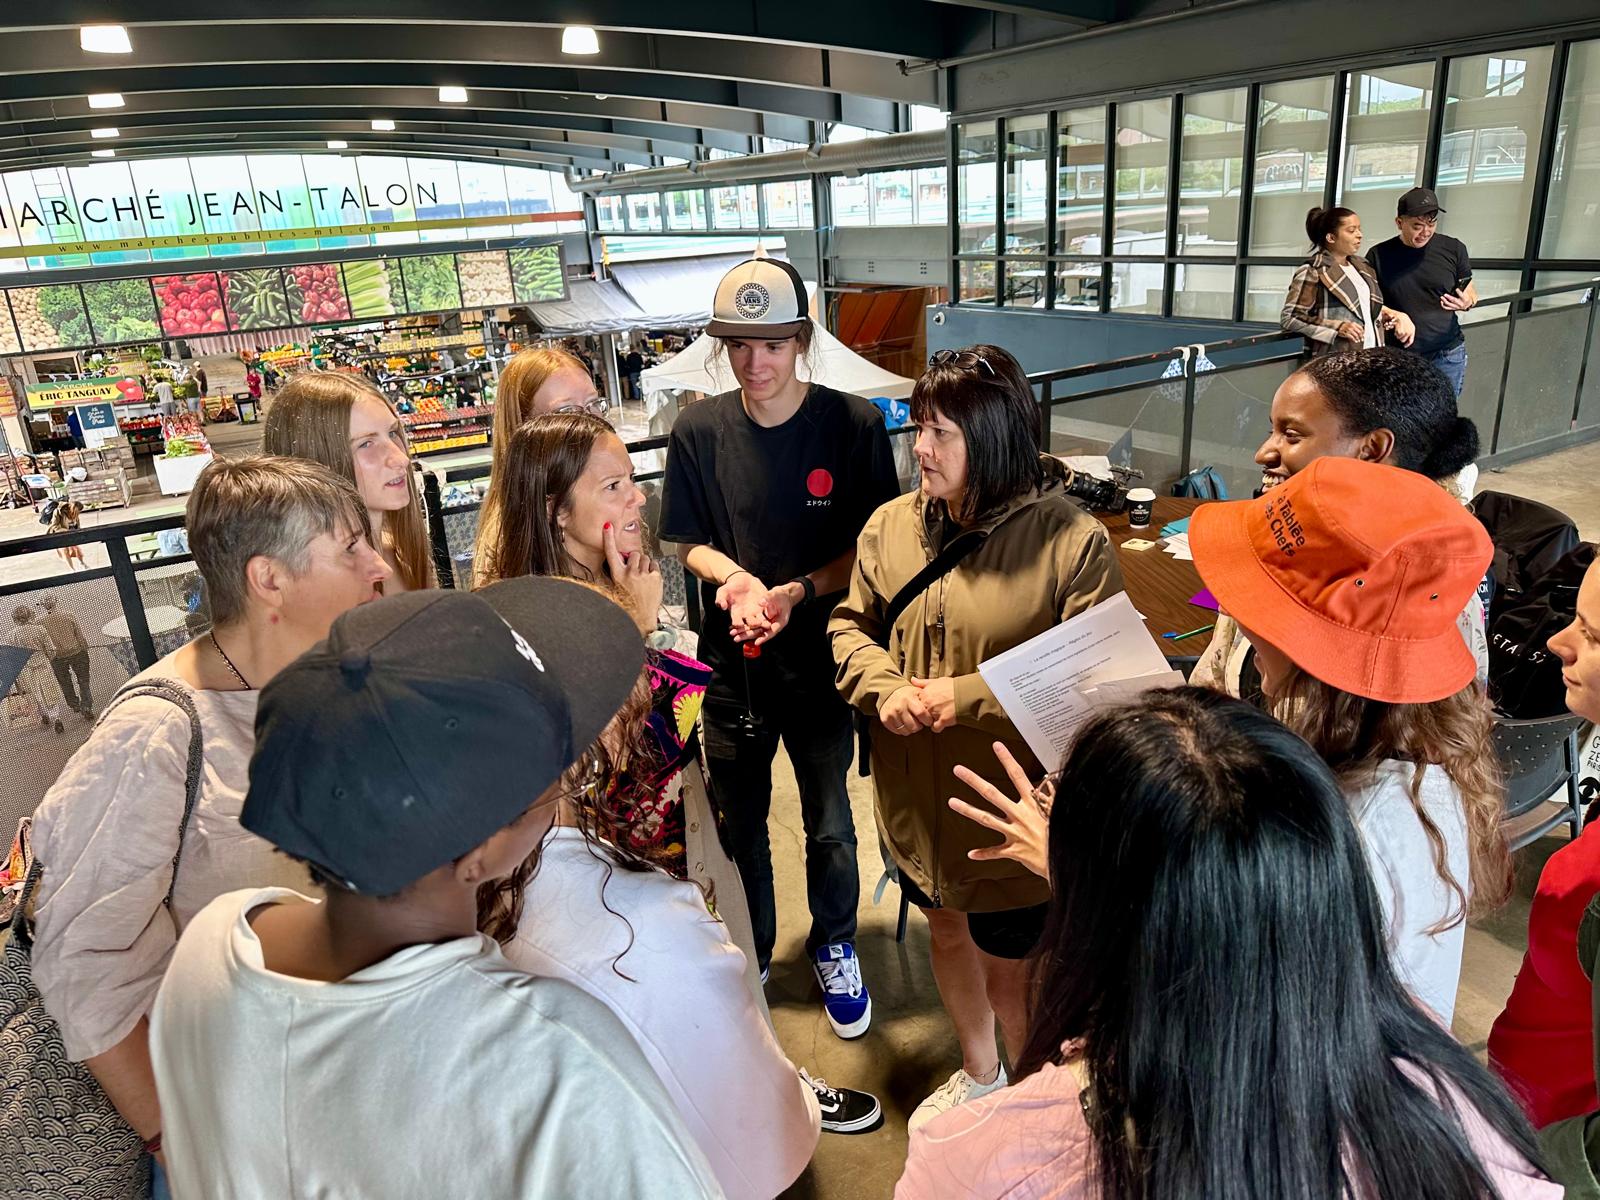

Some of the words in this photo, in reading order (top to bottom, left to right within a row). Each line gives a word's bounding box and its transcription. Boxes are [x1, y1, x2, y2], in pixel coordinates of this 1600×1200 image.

[0, 188, 165, 230] ARCHÉ
[58, 224, 391, 252] www.marchespublics-mtl.com
[744, 296, 761, 304] VANS
[382, 341, 413, 351] FERME
[443, 333, 481, 346] LUSSIER
[39, 391, 64, 401] ÉRIC
[66, 387, 112, 399] TANGUAY
[1270, 519, 1296, 557] Chefs
